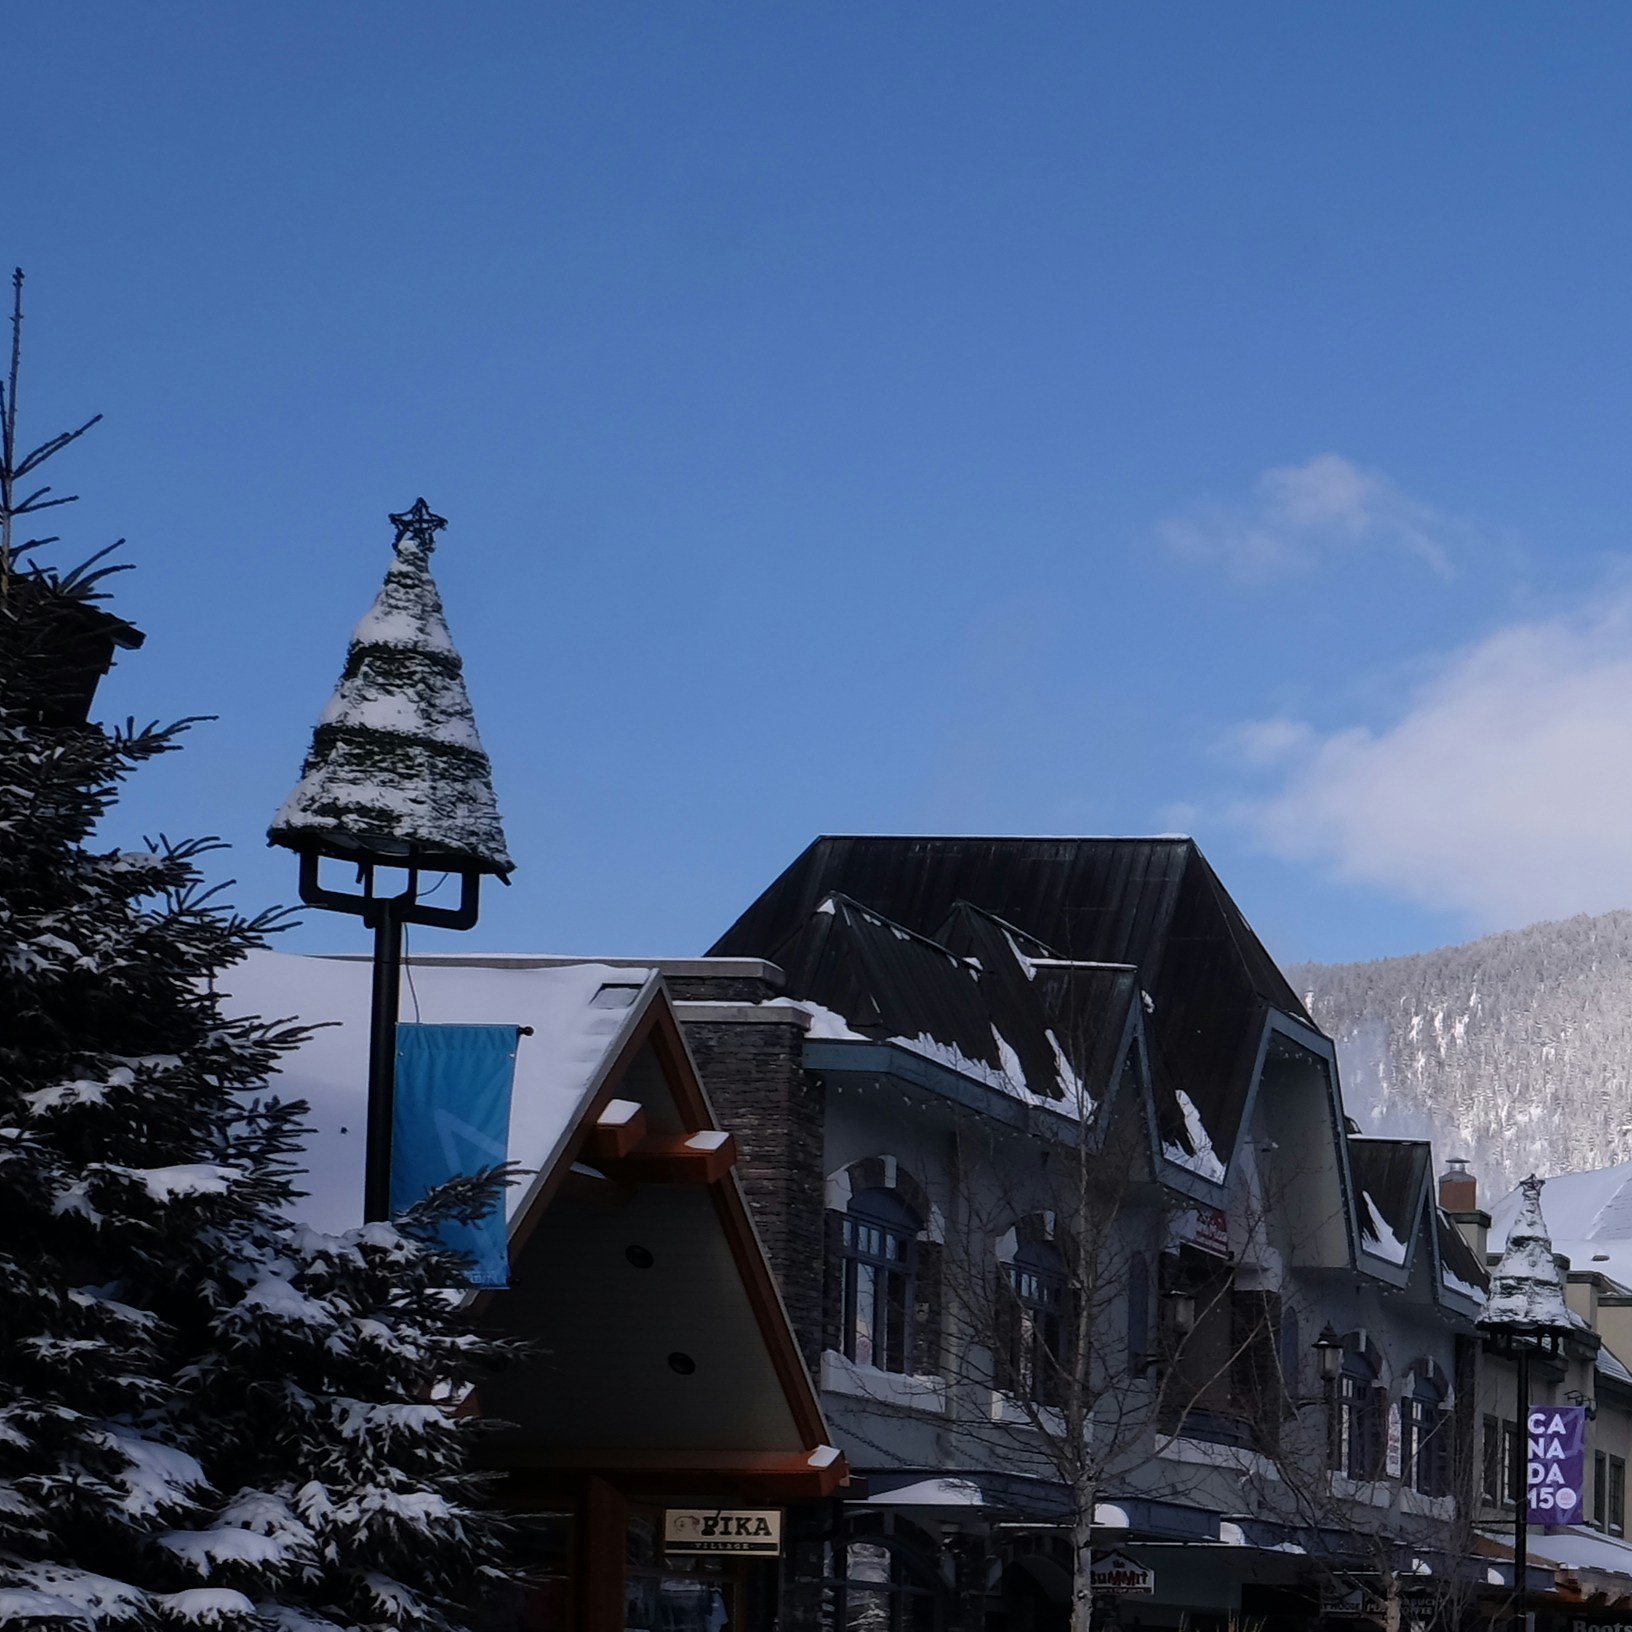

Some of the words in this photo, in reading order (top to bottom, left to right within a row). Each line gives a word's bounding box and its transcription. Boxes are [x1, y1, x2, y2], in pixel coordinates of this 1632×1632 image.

[1528, 1413, 1566, 1434] CA
[1528, 1437, 1565, 1459] NA
[1528, 1462, 1565, 1484] DA
[1527, 1487, 1577, 1510] 150
